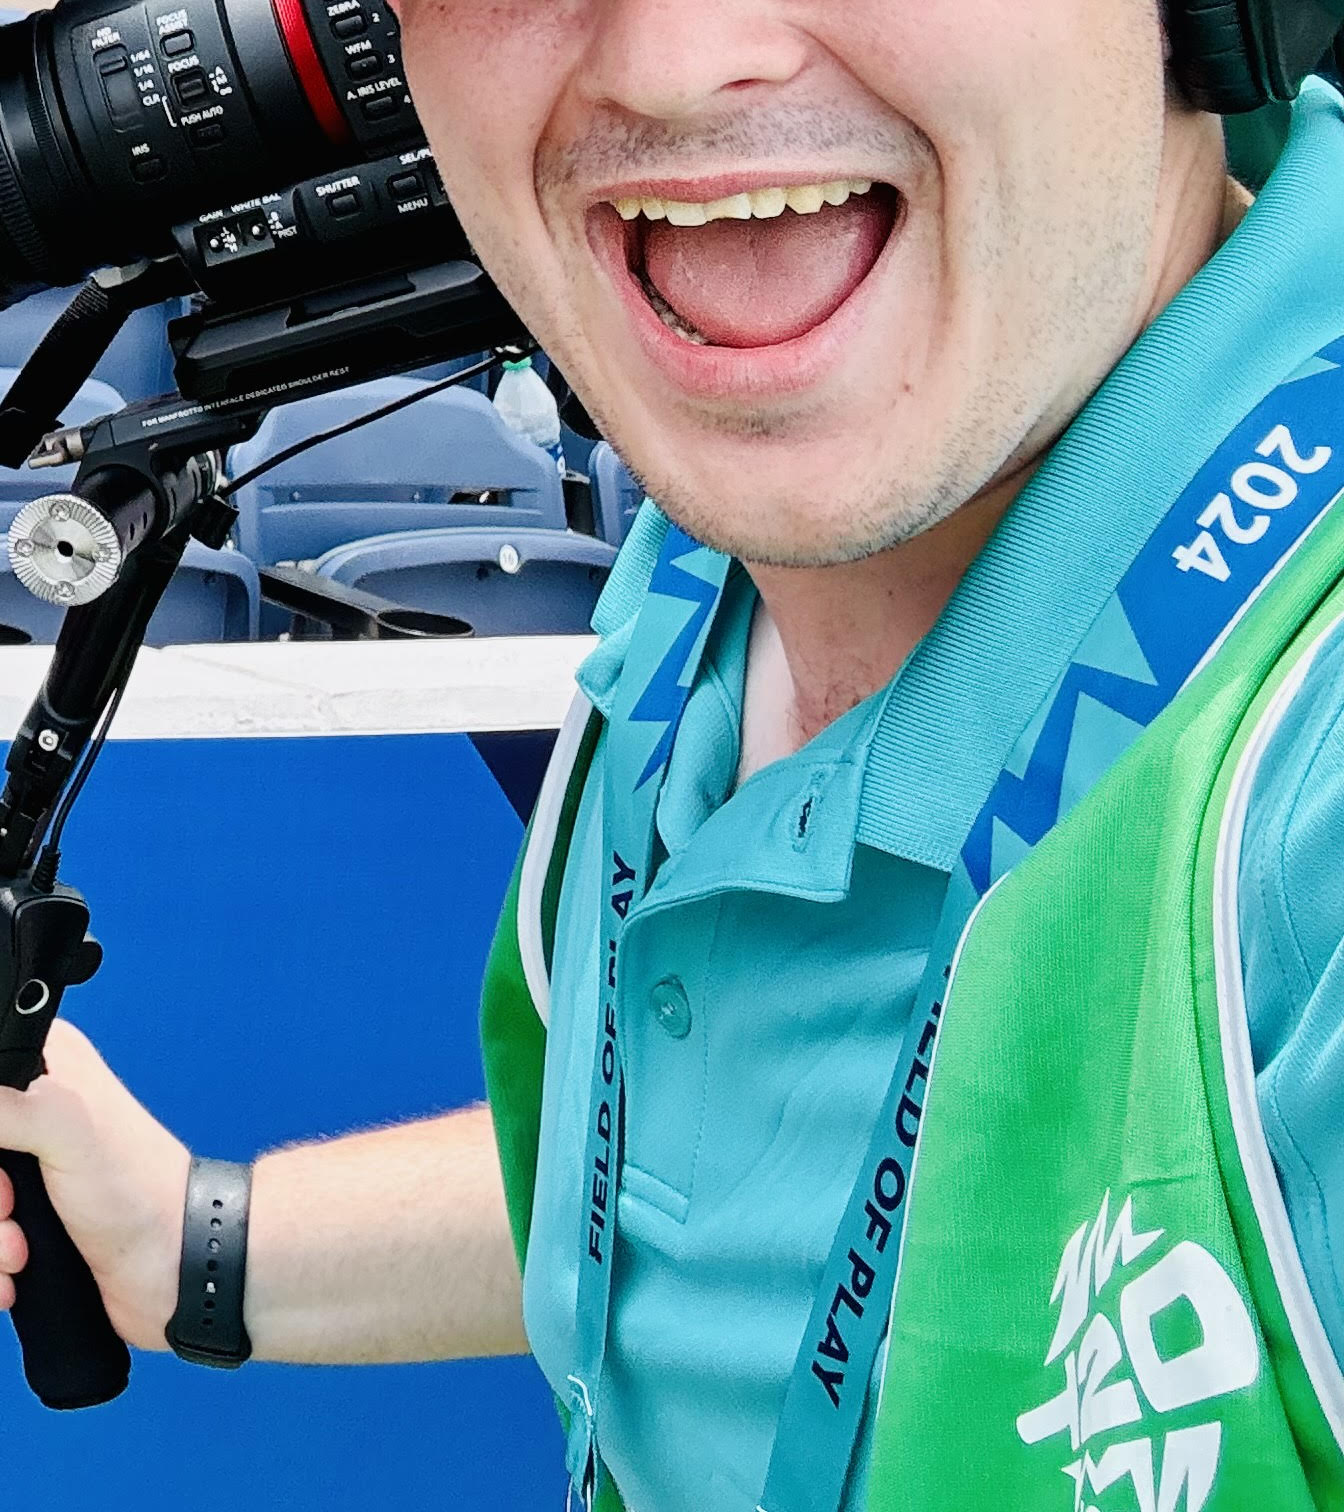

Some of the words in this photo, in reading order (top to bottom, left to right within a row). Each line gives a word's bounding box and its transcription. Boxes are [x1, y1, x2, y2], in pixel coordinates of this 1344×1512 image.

[326, 0, 360, 17] ZEBRA
[371, 12, 380, 23] 2
[345, 39, 372, 56] WFM
[167, 55, 200, 74] FOCUS
[387, 54, 396, 64] 3
[375, 76, 402, 93] LEVEL
[142, 93, 161, 107] CLR
[180, 113, 202, 127] PUSH
[202, 105, 224, 120] AUTO
[131, 143, 150, 156] IRIS
[315, 175, 361, 198] SHUTTER
[230, 197, 261, 214] WHITE
[261, 192, 282, 205] BAL
[397, 198, 429, 214] MENU
[198, 209, 224, 224] GAIN
[141, 417, 159, 428] FOR
[245, 382, 288, 400] DEDICATED
[1171, 423, 1332, 583] 2024
[588, 1099, 612, 1266] FIELD
[864, 1156, 906, 1253] OF
[812, 1248, 877, 1409] PLAY
